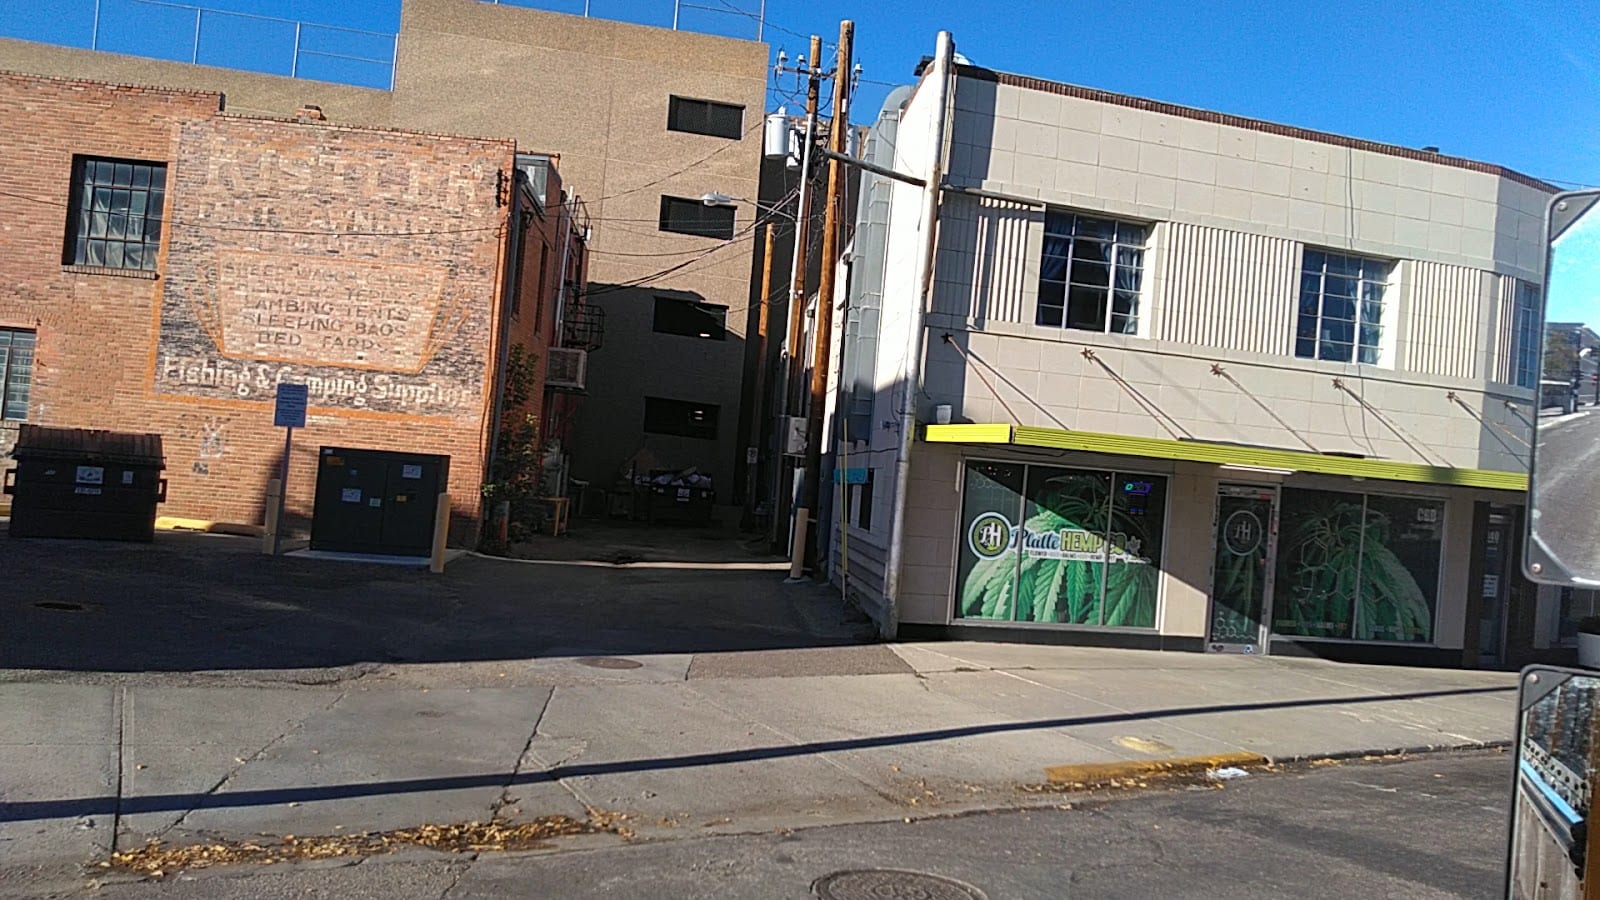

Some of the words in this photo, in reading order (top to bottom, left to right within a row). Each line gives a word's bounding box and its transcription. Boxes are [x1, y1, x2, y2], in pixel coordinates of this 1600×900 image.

[245, 295, 334, 316] LAMBING
[242, 312, 344, 333] SLEEPING
[163, 356, 250, 396] Fishing
[256, 364, 271, 389] &
[1062, 531, 1104, 554] HEMP
